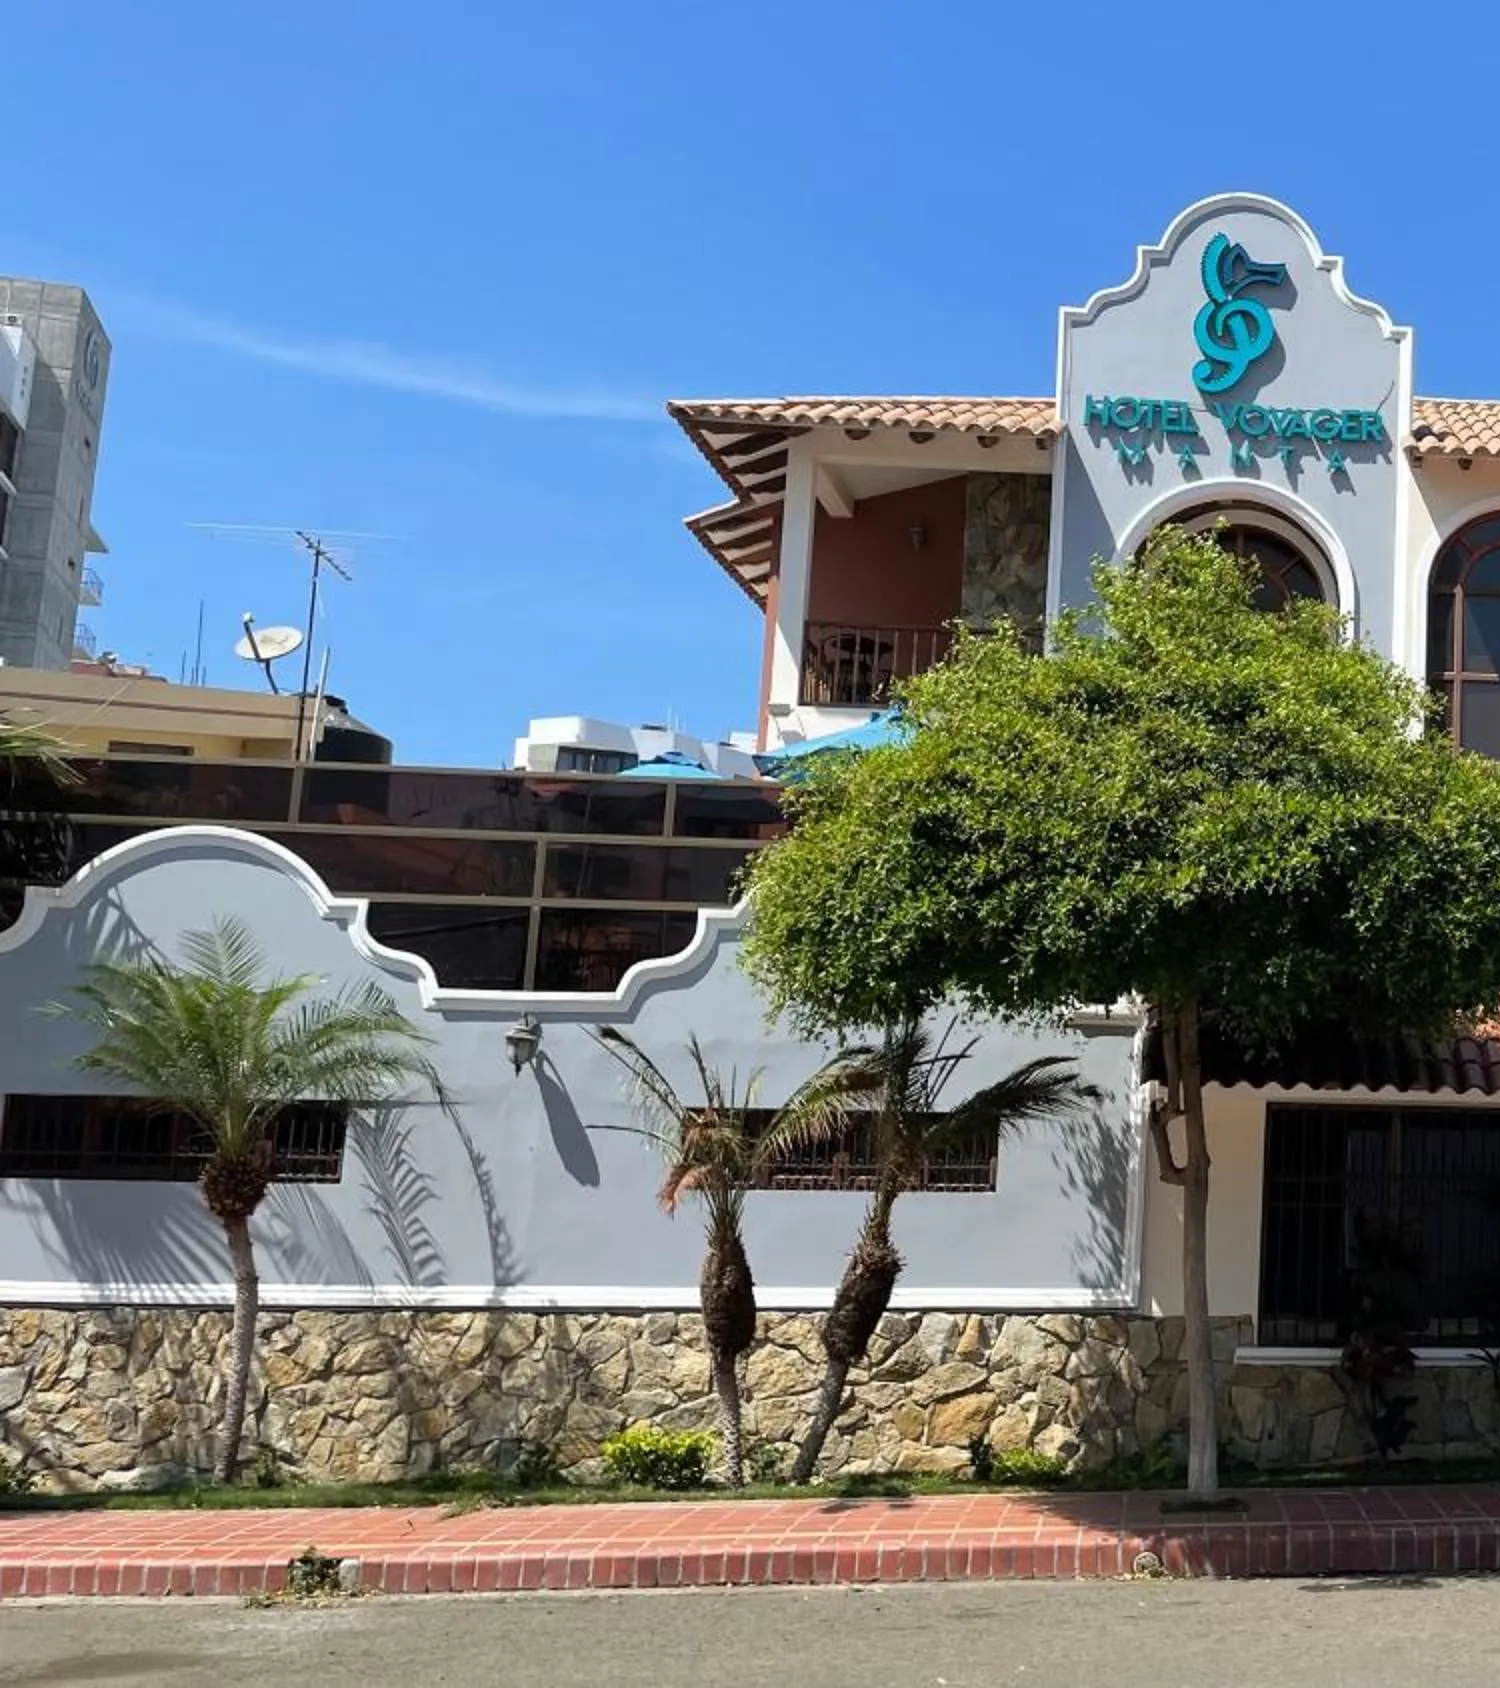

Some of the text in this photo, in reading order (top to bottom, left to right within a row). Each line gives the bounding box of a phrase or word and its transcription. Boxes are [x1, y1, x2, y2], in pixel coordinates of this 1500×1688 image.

[1084, 394, 1384, 441] HOTEL VOYAGER
[1118, 437, 1346, 472] MANTA
